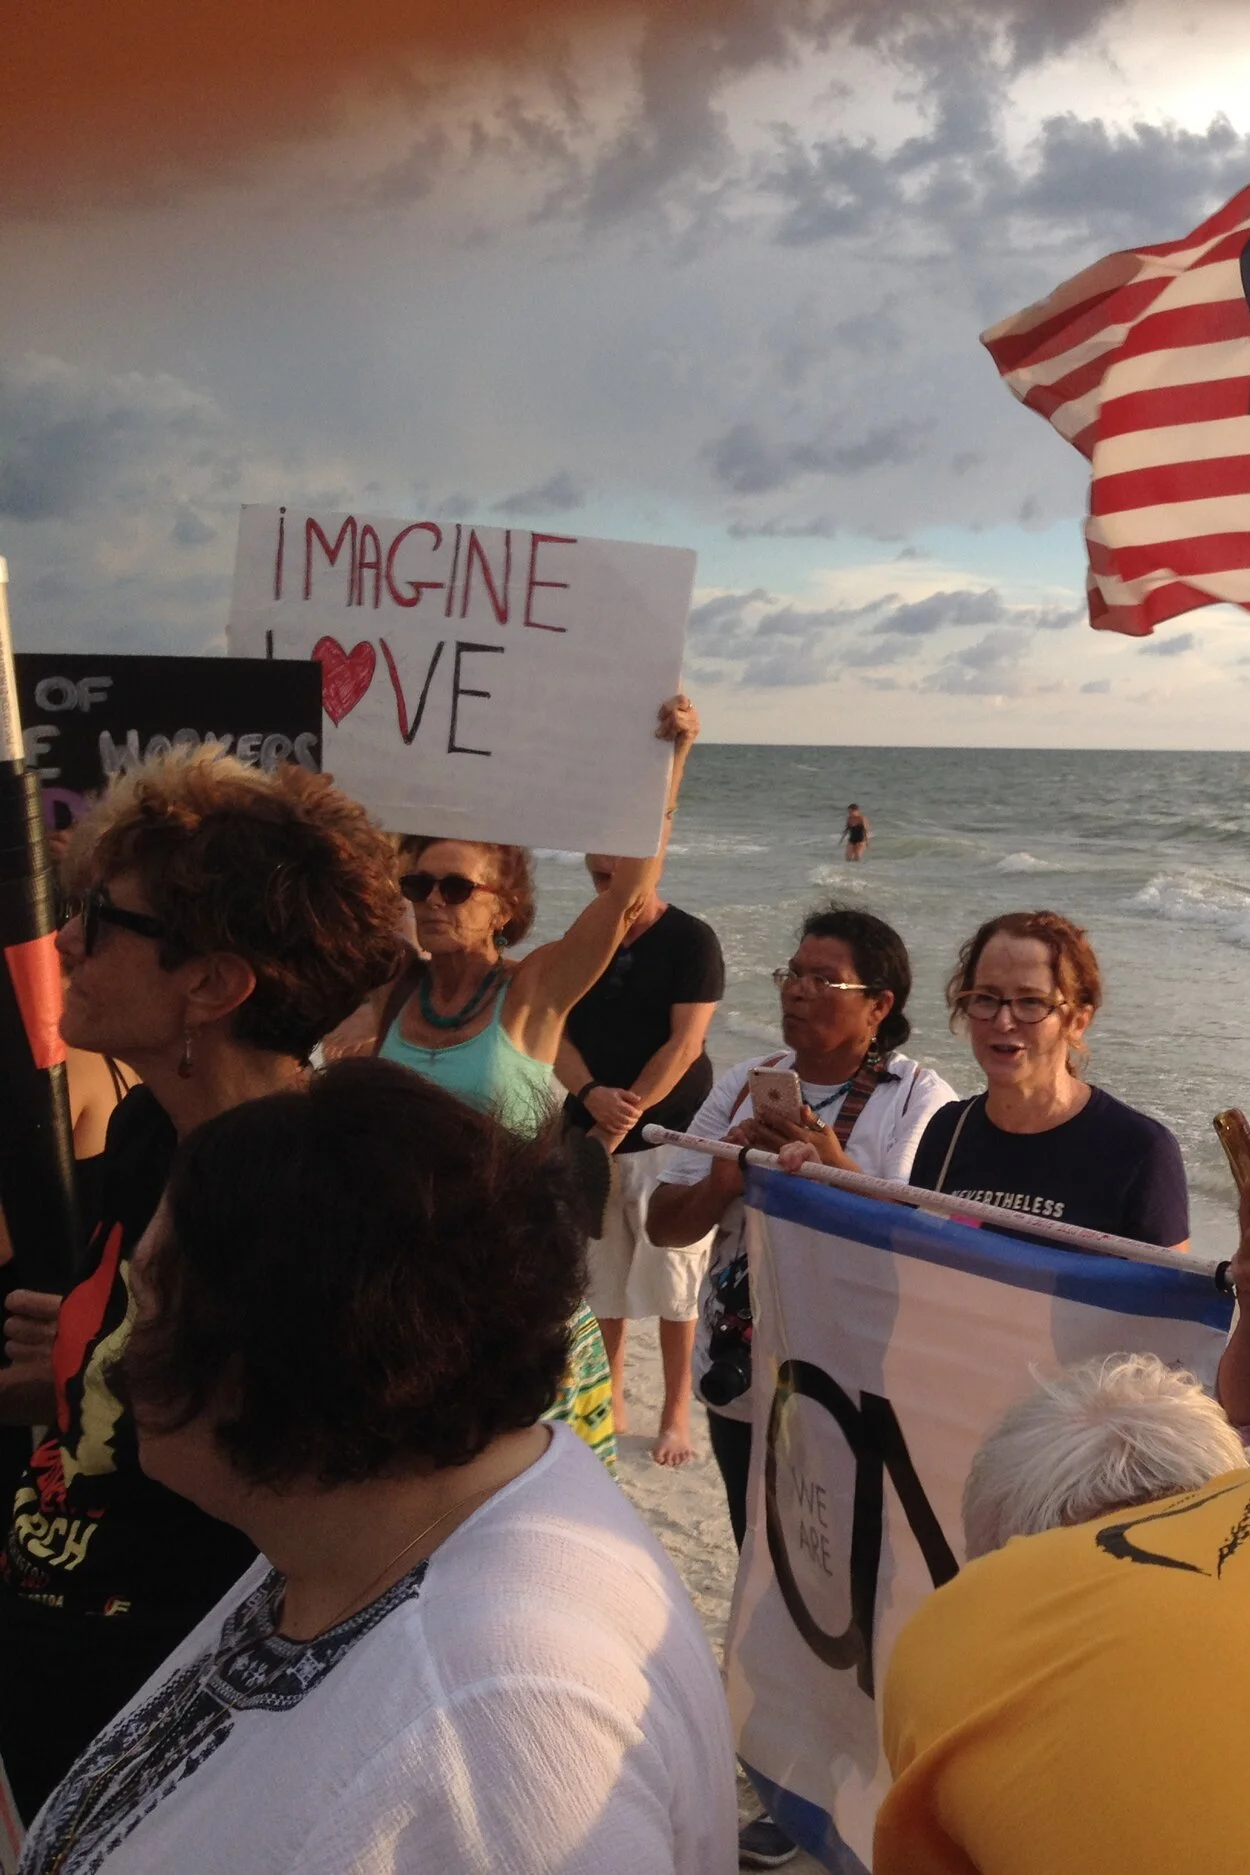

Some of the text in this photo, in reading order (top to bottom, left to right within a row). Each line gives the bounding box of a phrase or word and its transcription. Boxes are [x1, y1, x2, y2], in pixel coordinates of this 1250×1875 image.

[34, 676, 113, 712] OF
[791, 1465, 828, 1529] WE
[799, 1518, 834, 1577] ARE
